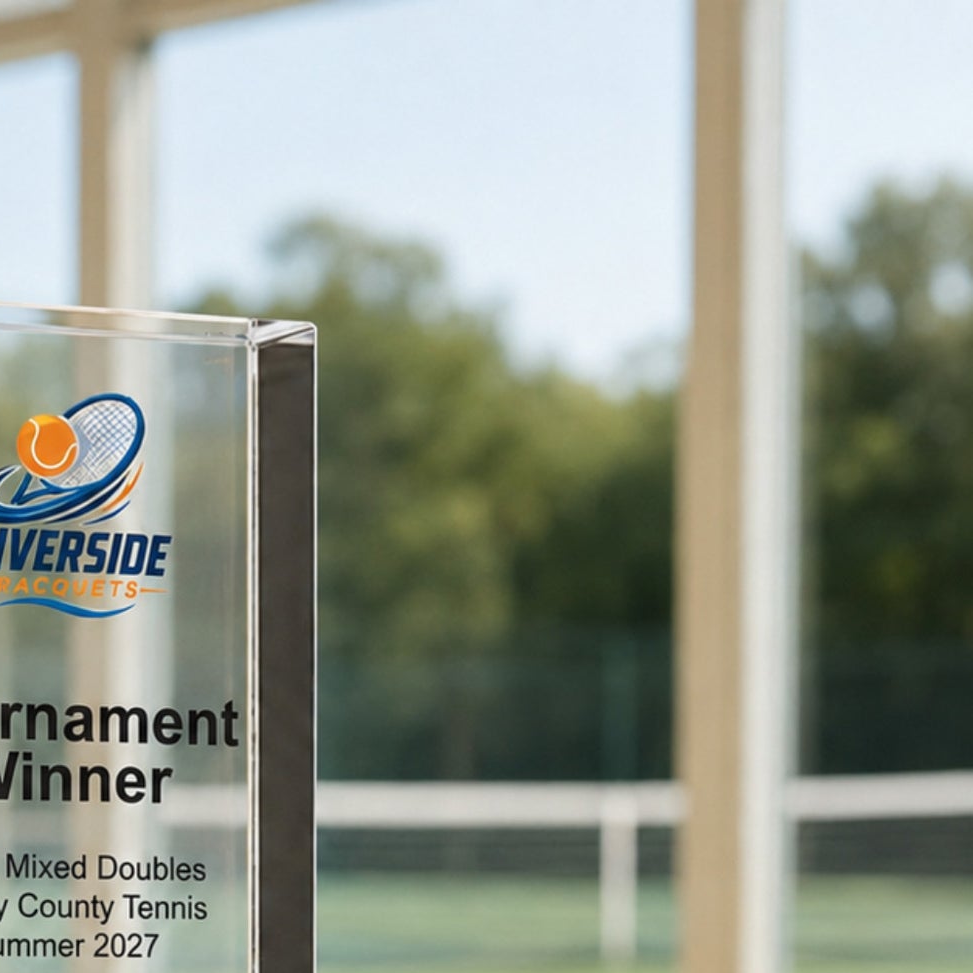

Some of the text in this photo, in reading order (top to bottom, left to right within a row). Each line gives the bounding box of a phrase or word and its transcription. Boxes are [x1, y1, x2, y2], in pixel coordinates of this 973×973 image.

[5, 853, 87, 881] Mixed
[98, 855, 207, 882] Doubles
[18, 892, 115, 925] County
[123, 894, 208, 920] Tennis
[93, 933, 159, 959] 2027
